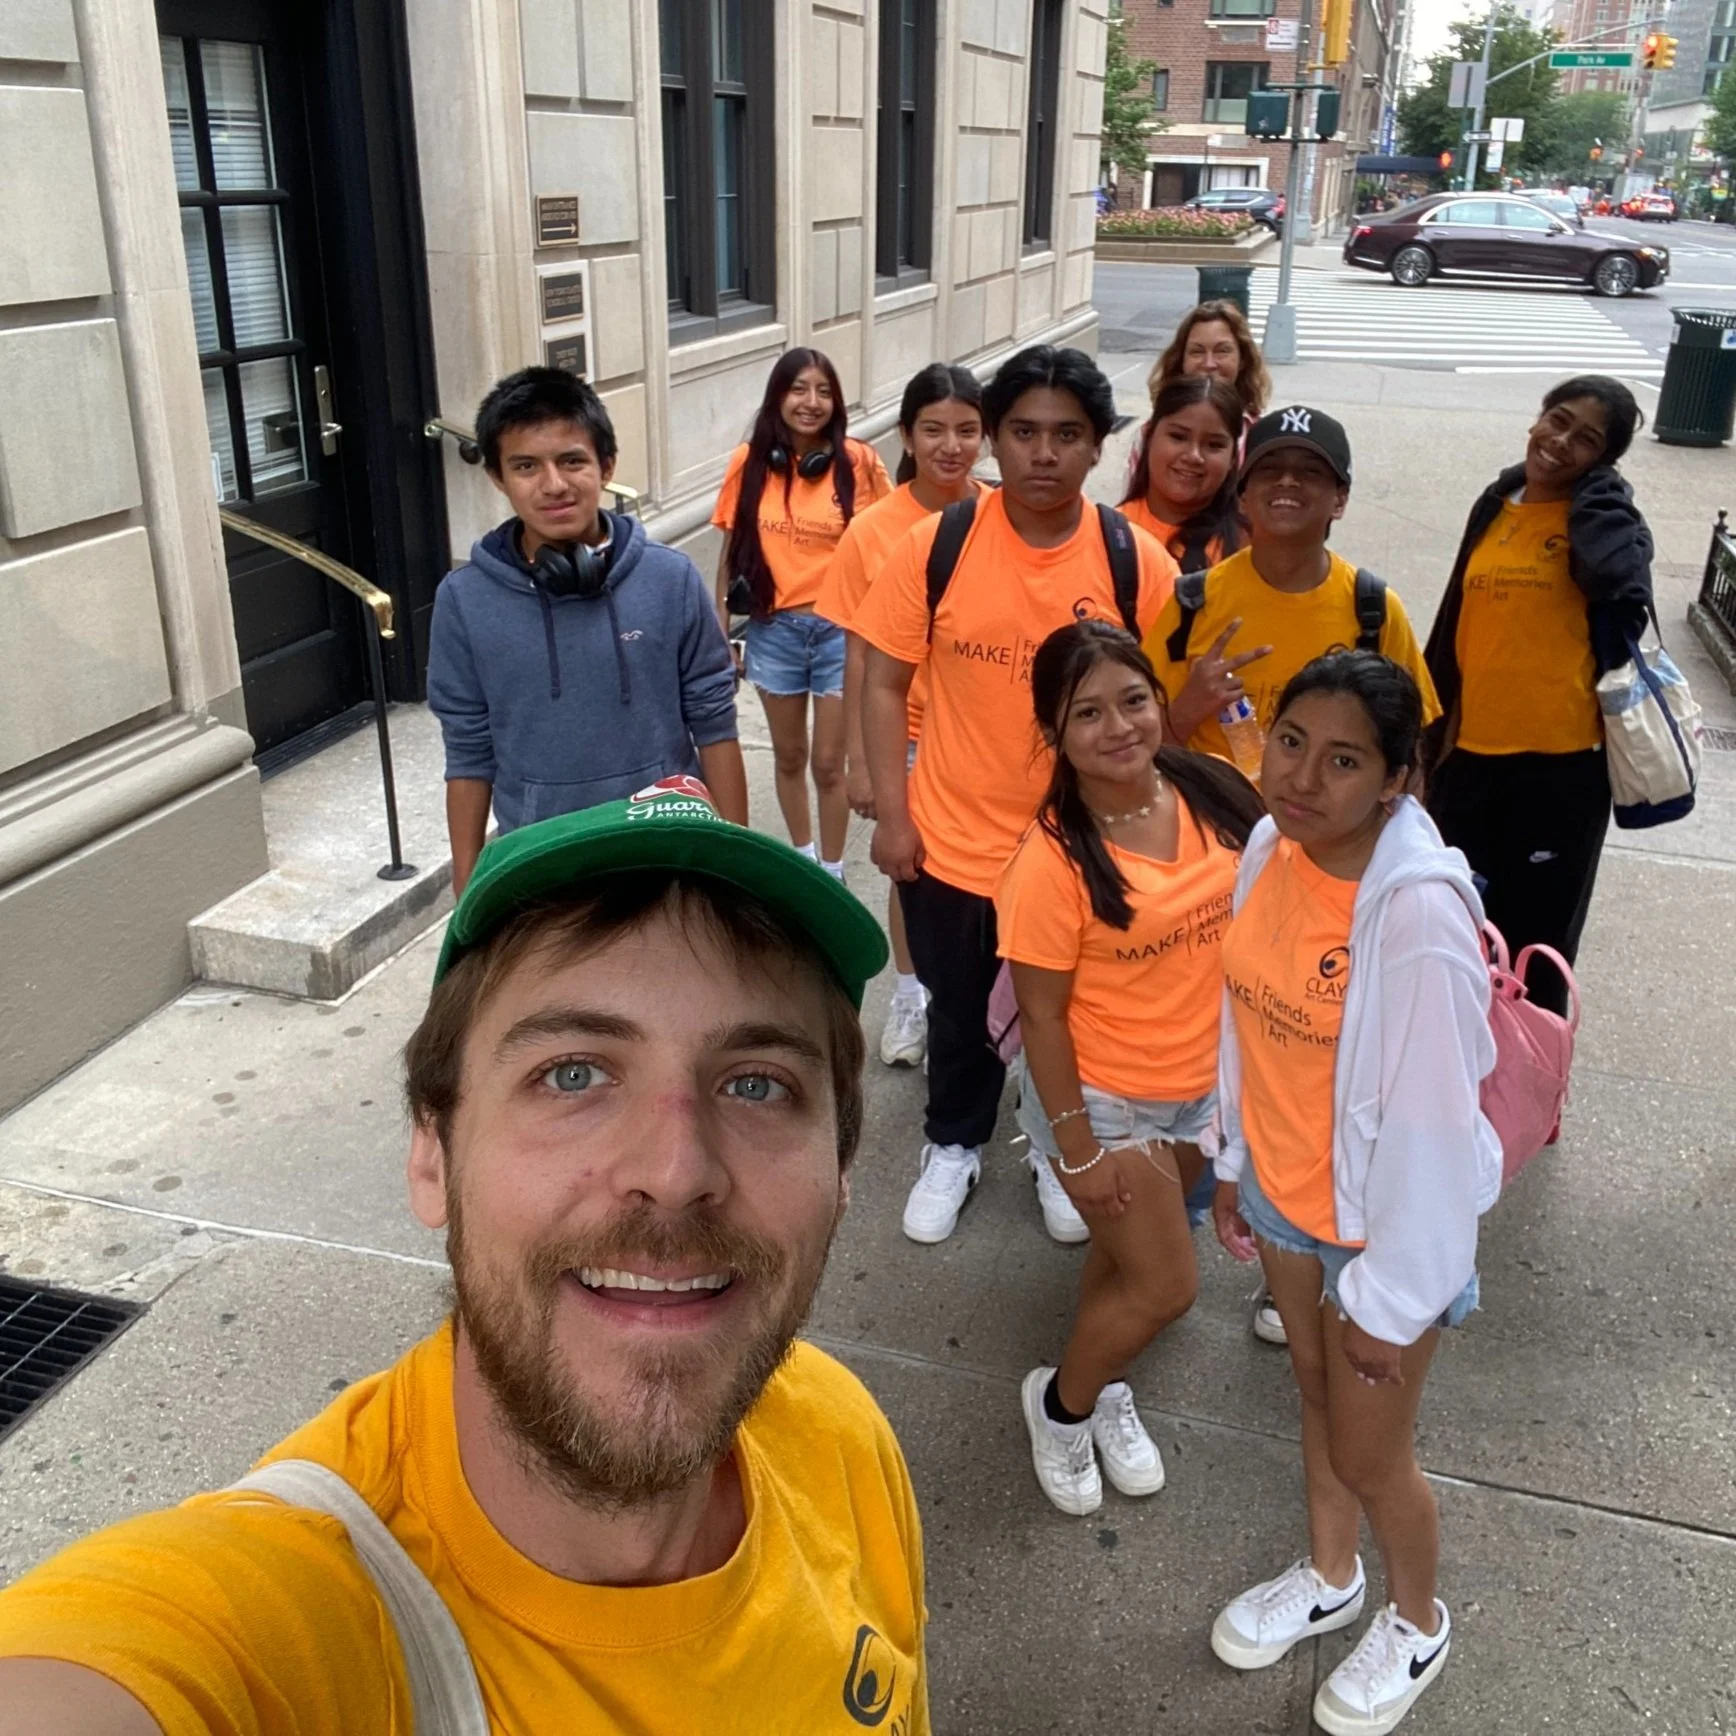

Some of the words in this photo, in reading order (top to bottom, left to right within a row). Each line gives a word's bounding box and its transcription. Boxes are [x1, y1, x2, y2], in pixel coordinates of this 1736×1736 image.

[1577, 55, 1594, 64] Park
[1280, 408, 1312, 433] NY
[759, 519, 788, 534] AKE
[1469, 573, 1488, 589] KE
[954, 640, 1012, 666] MAKE
[627, 801, 713, 820] Guar
[1196, 892, 1233, 919] Frien
[1197, 908, 1233, 932] Mem
[1115, 927, 1184, 961] MAKE
[1197, 929, 1220, 948] Art
[1225, 974, 1252, 1002] AKE
[1306, 976, 1347, 998] CLAY
[1261, 985, 1312, 1027] Friends
[1269, 1024, 1287, 1048] Art
